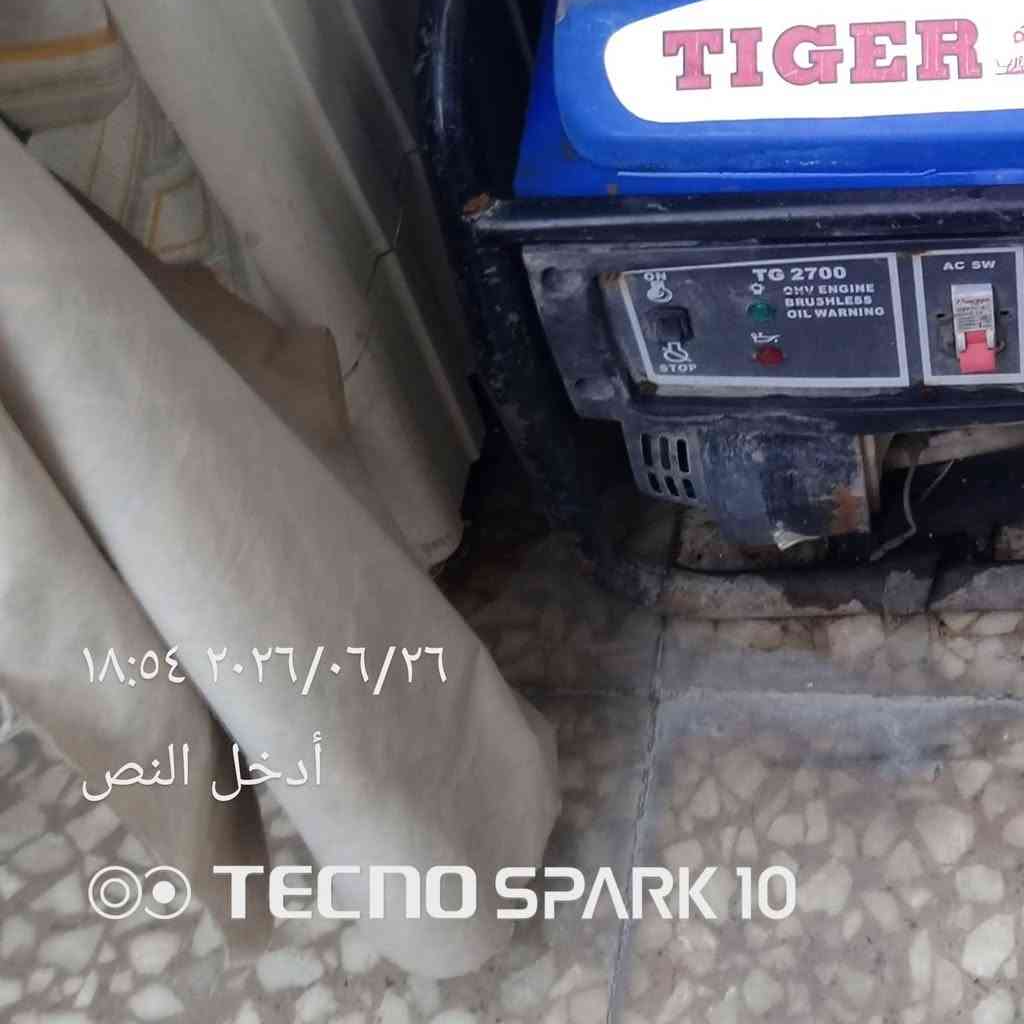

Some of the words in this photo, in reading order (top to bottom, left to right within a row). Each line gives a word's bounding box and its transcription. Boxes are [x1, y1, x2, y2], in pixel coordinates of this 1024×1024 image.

[662, 18, 983, 91] TIGER
[943, 261, 965, 271] AC
[971, 259, 996, 270] SW
[643, 272, 667, 281] ON
[752, 267, 785, 282] TG
[790, 266, 847, 281] 2700
[818, 283, 875, 295] ENGINE
[784, 295, 873, 308] BRUSHLESS
[786, 309, 812, 319] OIL
[814, 306, 885, 318] WARNING
[658, 363, 697, 373] STOP
